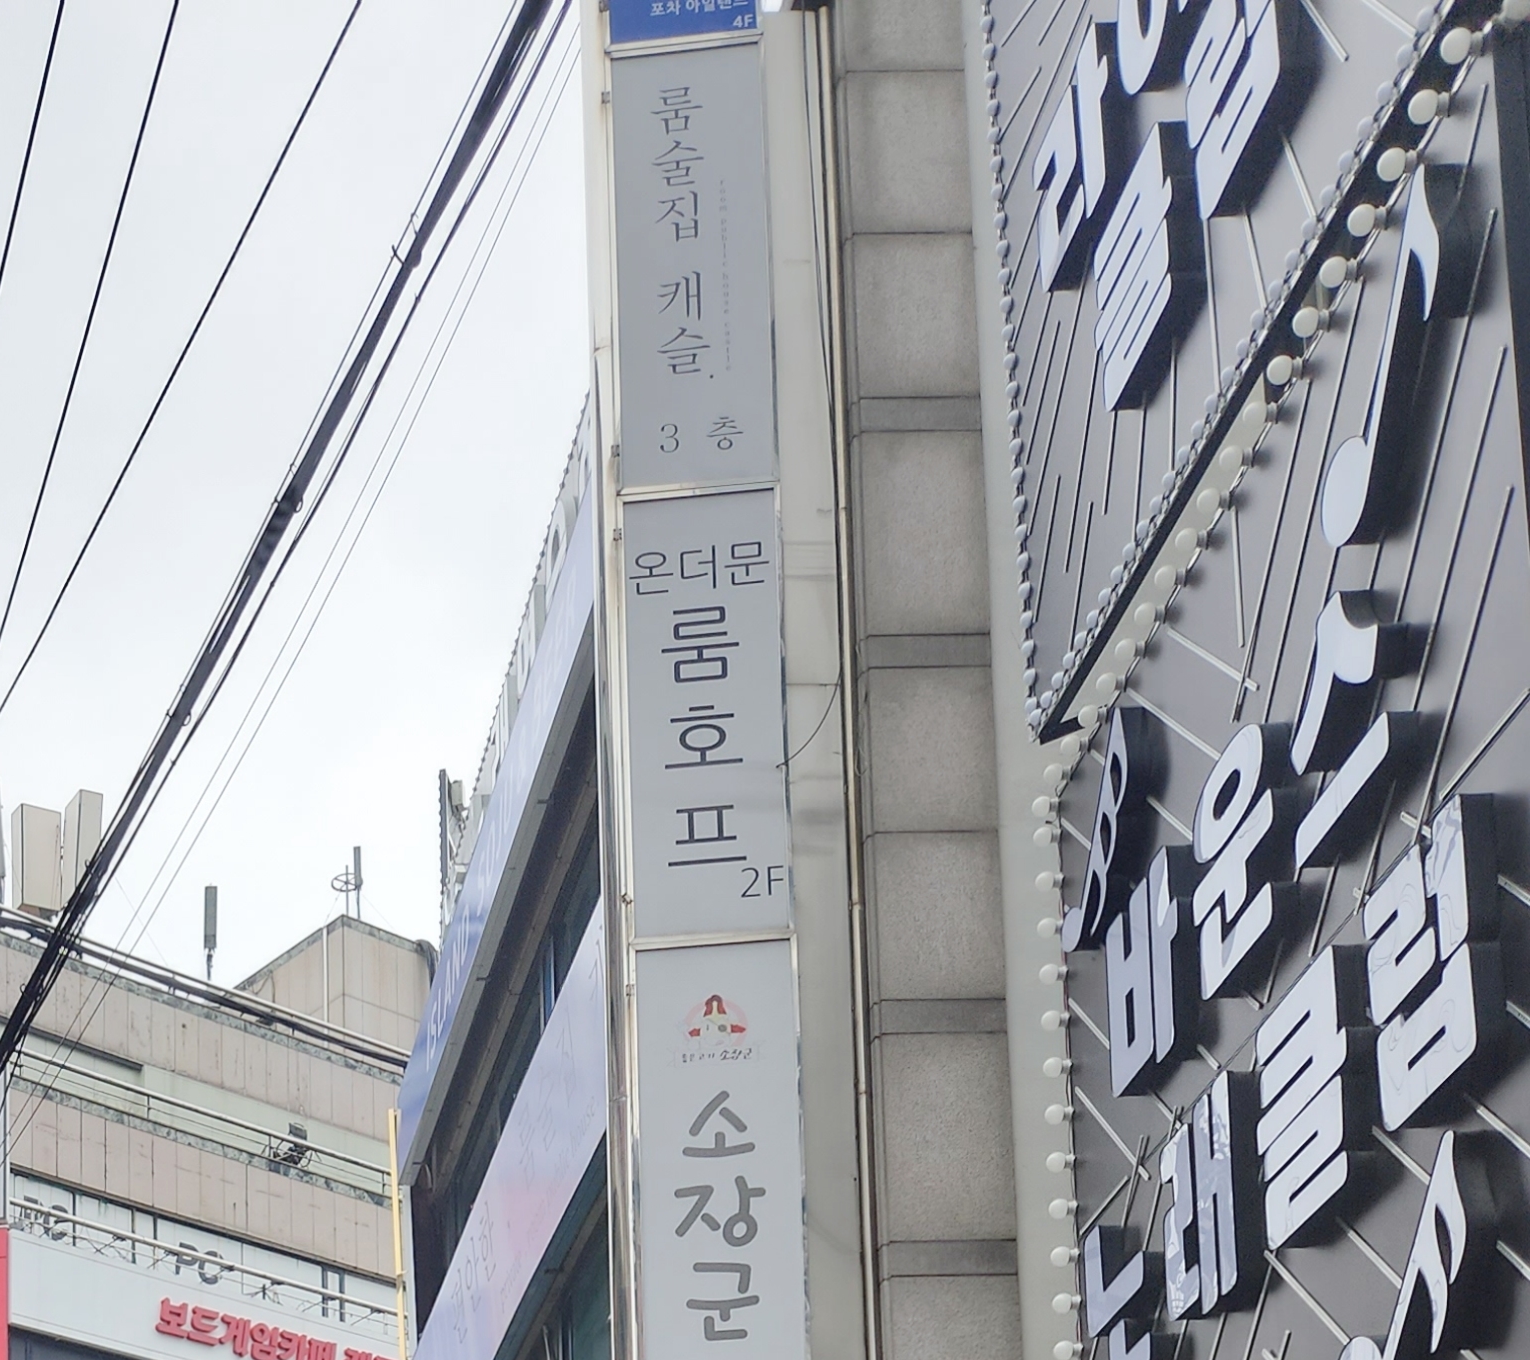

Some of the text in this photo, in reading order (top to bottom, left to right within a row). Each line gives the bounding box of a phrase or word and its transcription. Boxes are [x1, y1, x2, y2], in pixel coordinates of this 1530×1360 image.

[732, 15, 753, 28] 4F
[650, 85, 705, 244] 룸술집
[629, 539, 771, 599] 온더문
[659, 605, 747, 867] 룸호프
[740, 865, 784, 900] 2F
[672, 1089, 767, 1342] 소장군
